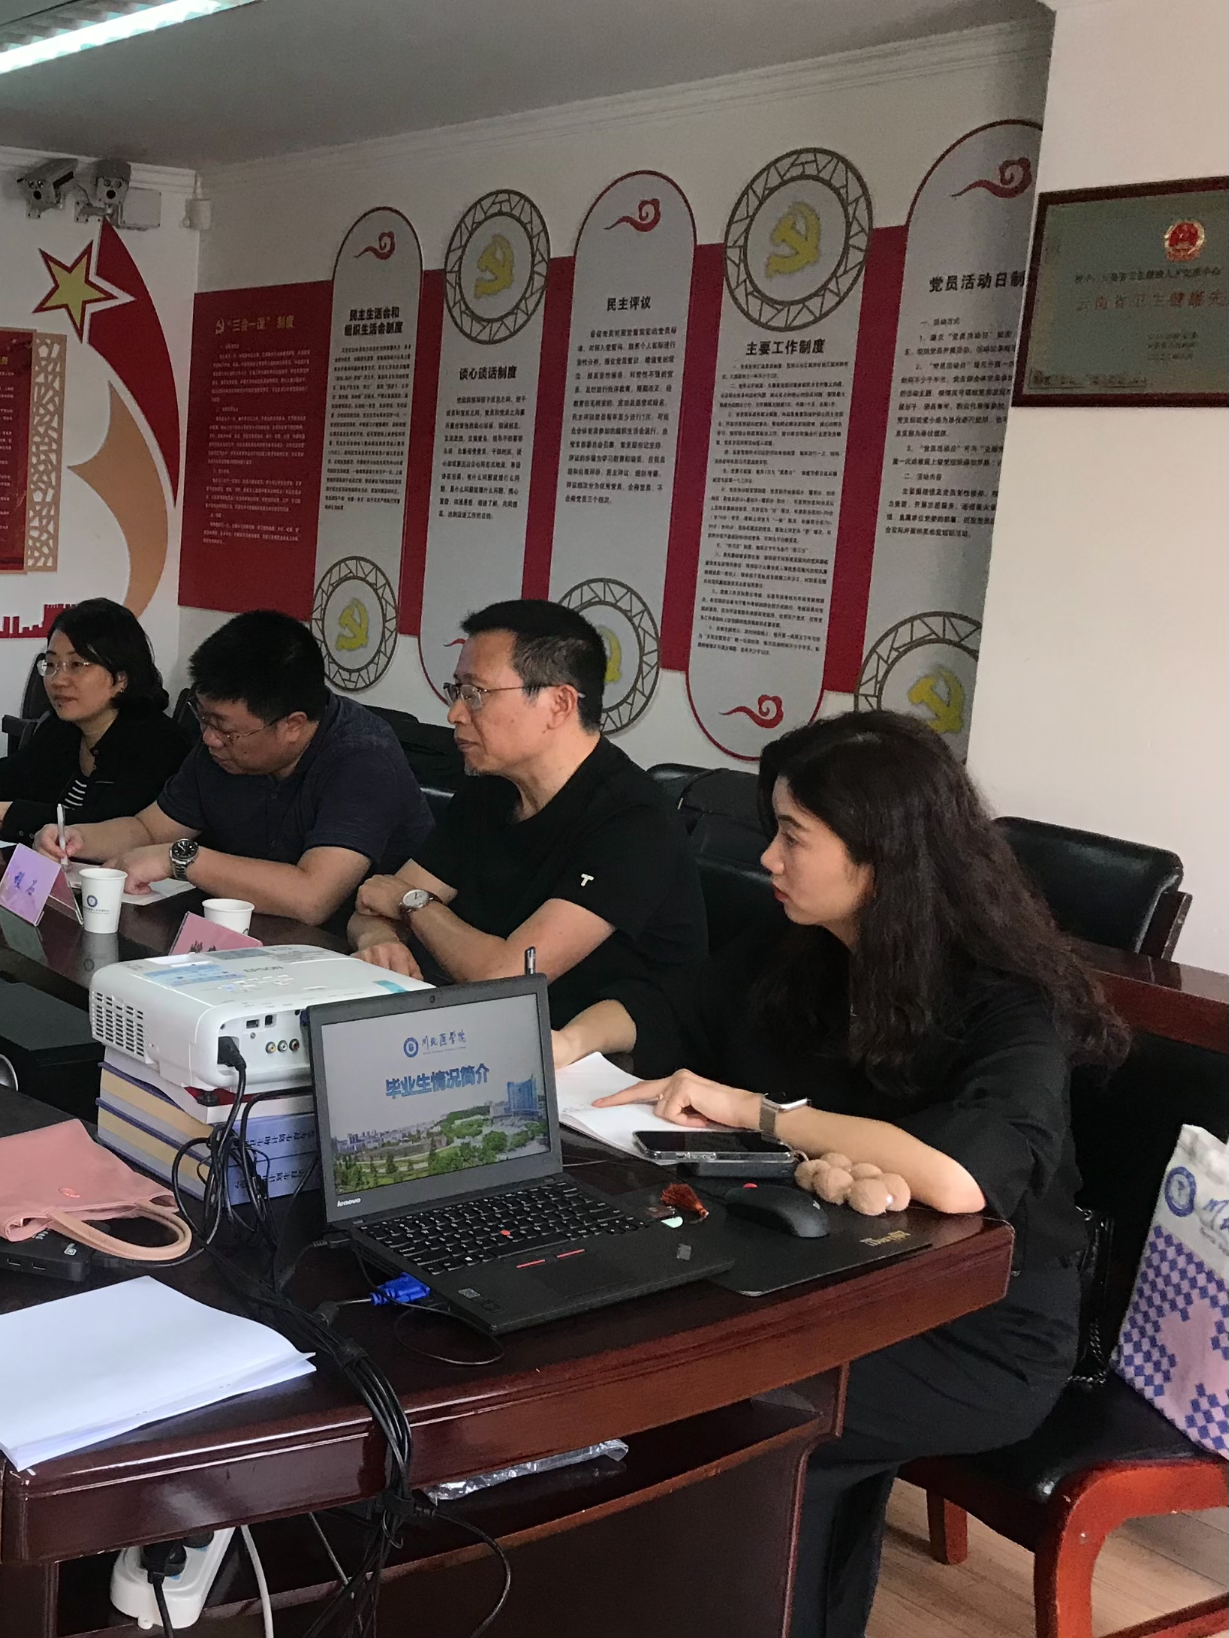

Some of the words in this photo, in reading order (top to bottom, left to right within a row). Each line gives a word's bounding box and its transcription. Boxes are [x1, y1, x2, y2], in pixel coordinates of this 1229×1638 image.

[606, 296, 651, 312] 民主评议
[349, 306, 400, 322] 民主生活会和
[344, 321, 403, 337] 组织生活会制度
[745, 339, 826, 356] 主要工作制度
[459, 365, 517, 381] 谈心谈话制度
[422, 1029, 467, 1050] 川北医学院
[385, 1063, 490, 1100] 毕业生情况简介
[337, 1198, 361, 1207] lenovo
